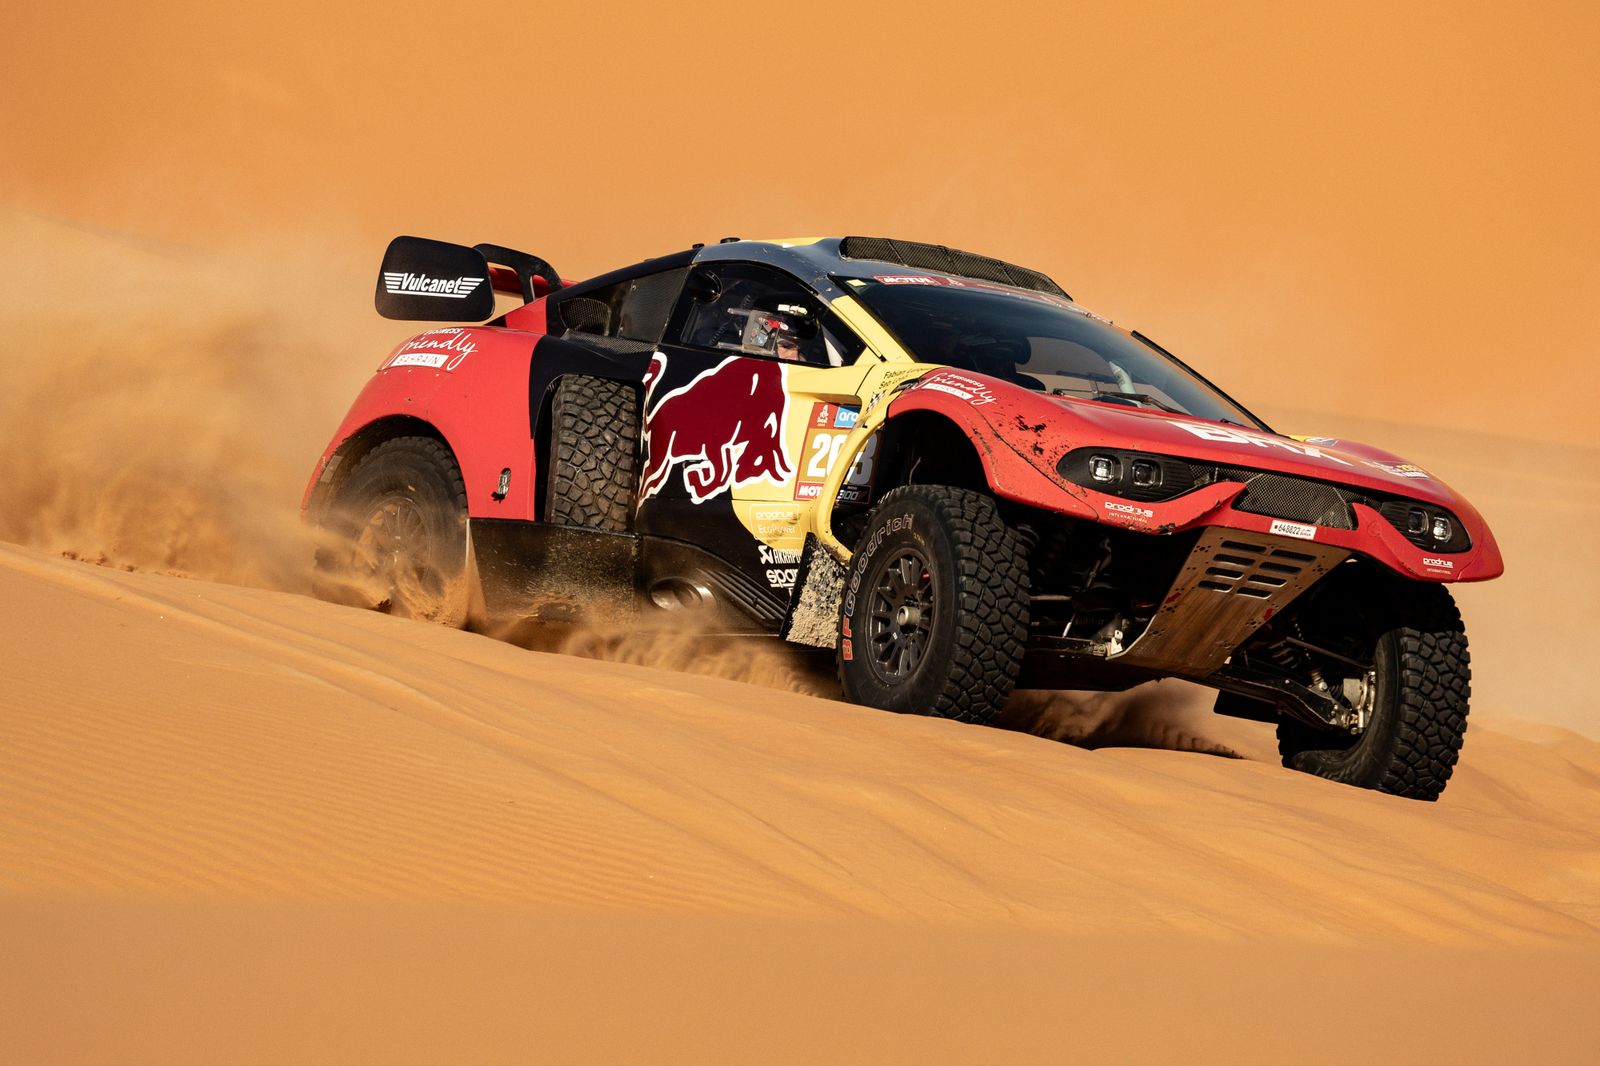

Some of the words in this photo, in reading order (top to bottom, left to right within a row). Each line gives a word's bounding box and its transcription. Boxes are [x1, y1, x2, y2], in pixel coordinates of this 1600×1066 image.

[401, 272, 463, 294] Vulcanet
[883, 276, 935, 284] MOTUL
[798, 485, 821, 497] MOT
[766, 569, 799, 588] spar
